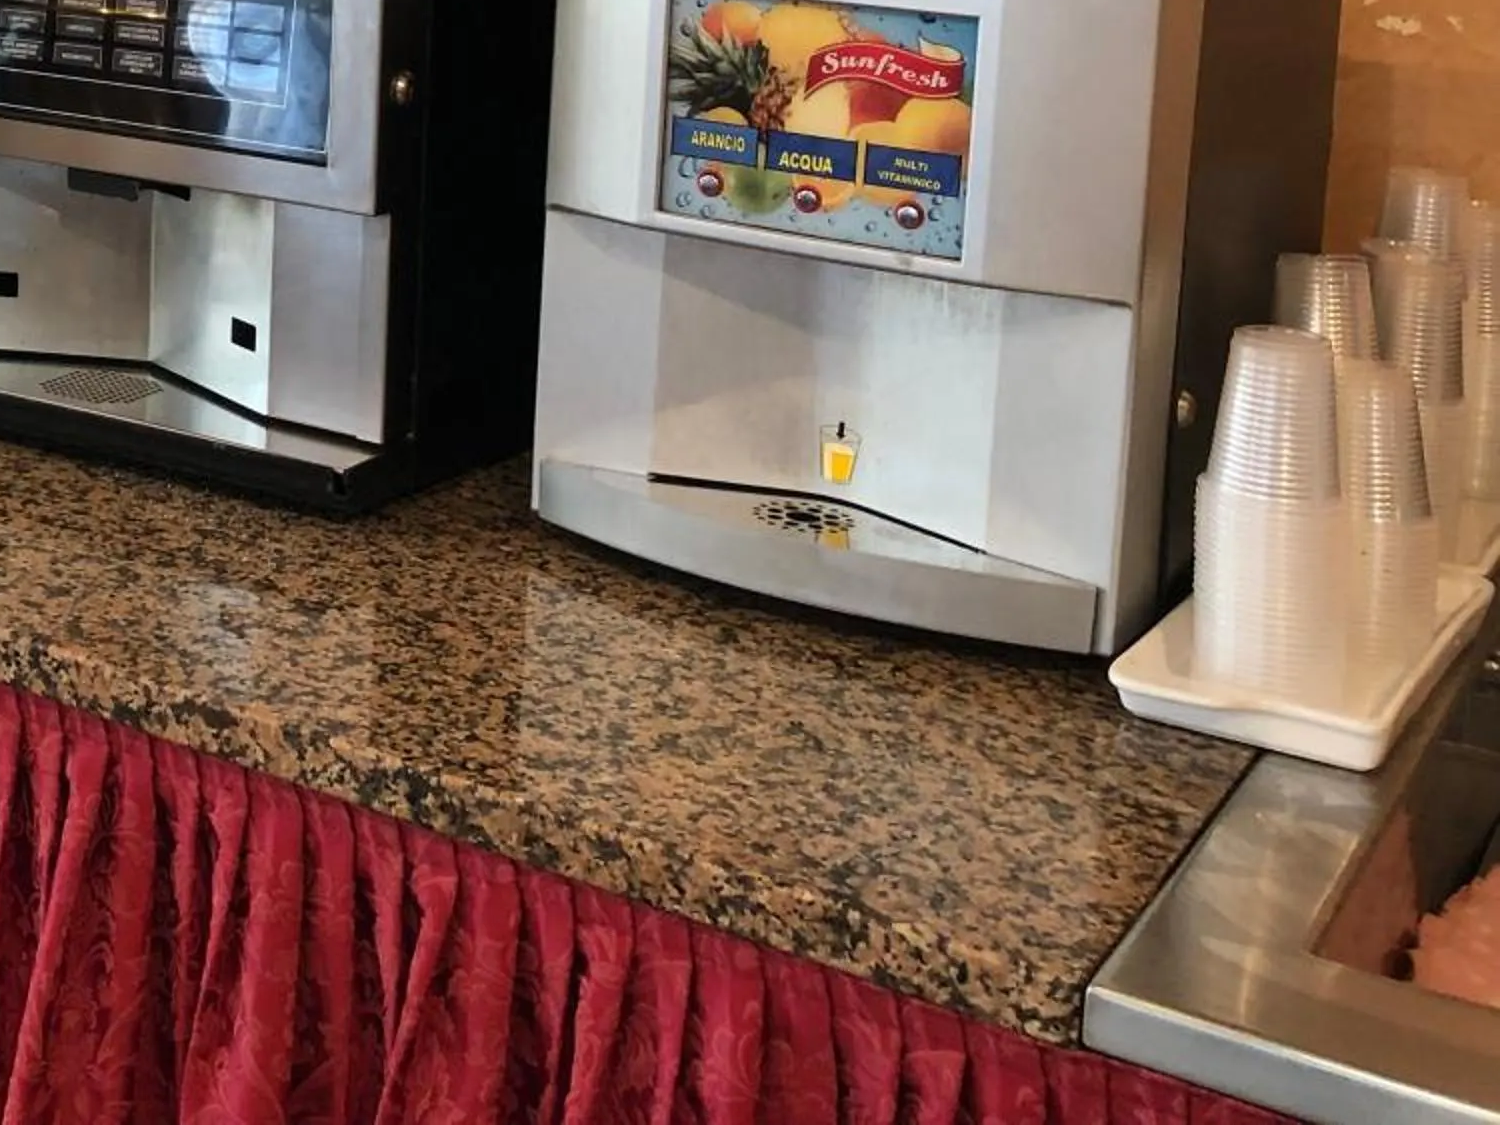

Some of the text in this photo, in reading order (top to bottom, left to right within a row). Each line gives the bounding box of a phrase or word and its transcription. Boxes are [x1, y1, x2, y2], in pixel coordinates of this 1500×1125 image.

[820, 51, 949, 89] Sunfresh
[691, 130, 746, 153] ARANCIO
[778, 150, 833, 174] ACQUA
[893, 157, 930, 173] MULTI
[876, 169, 941, 191] VITAMINICO
